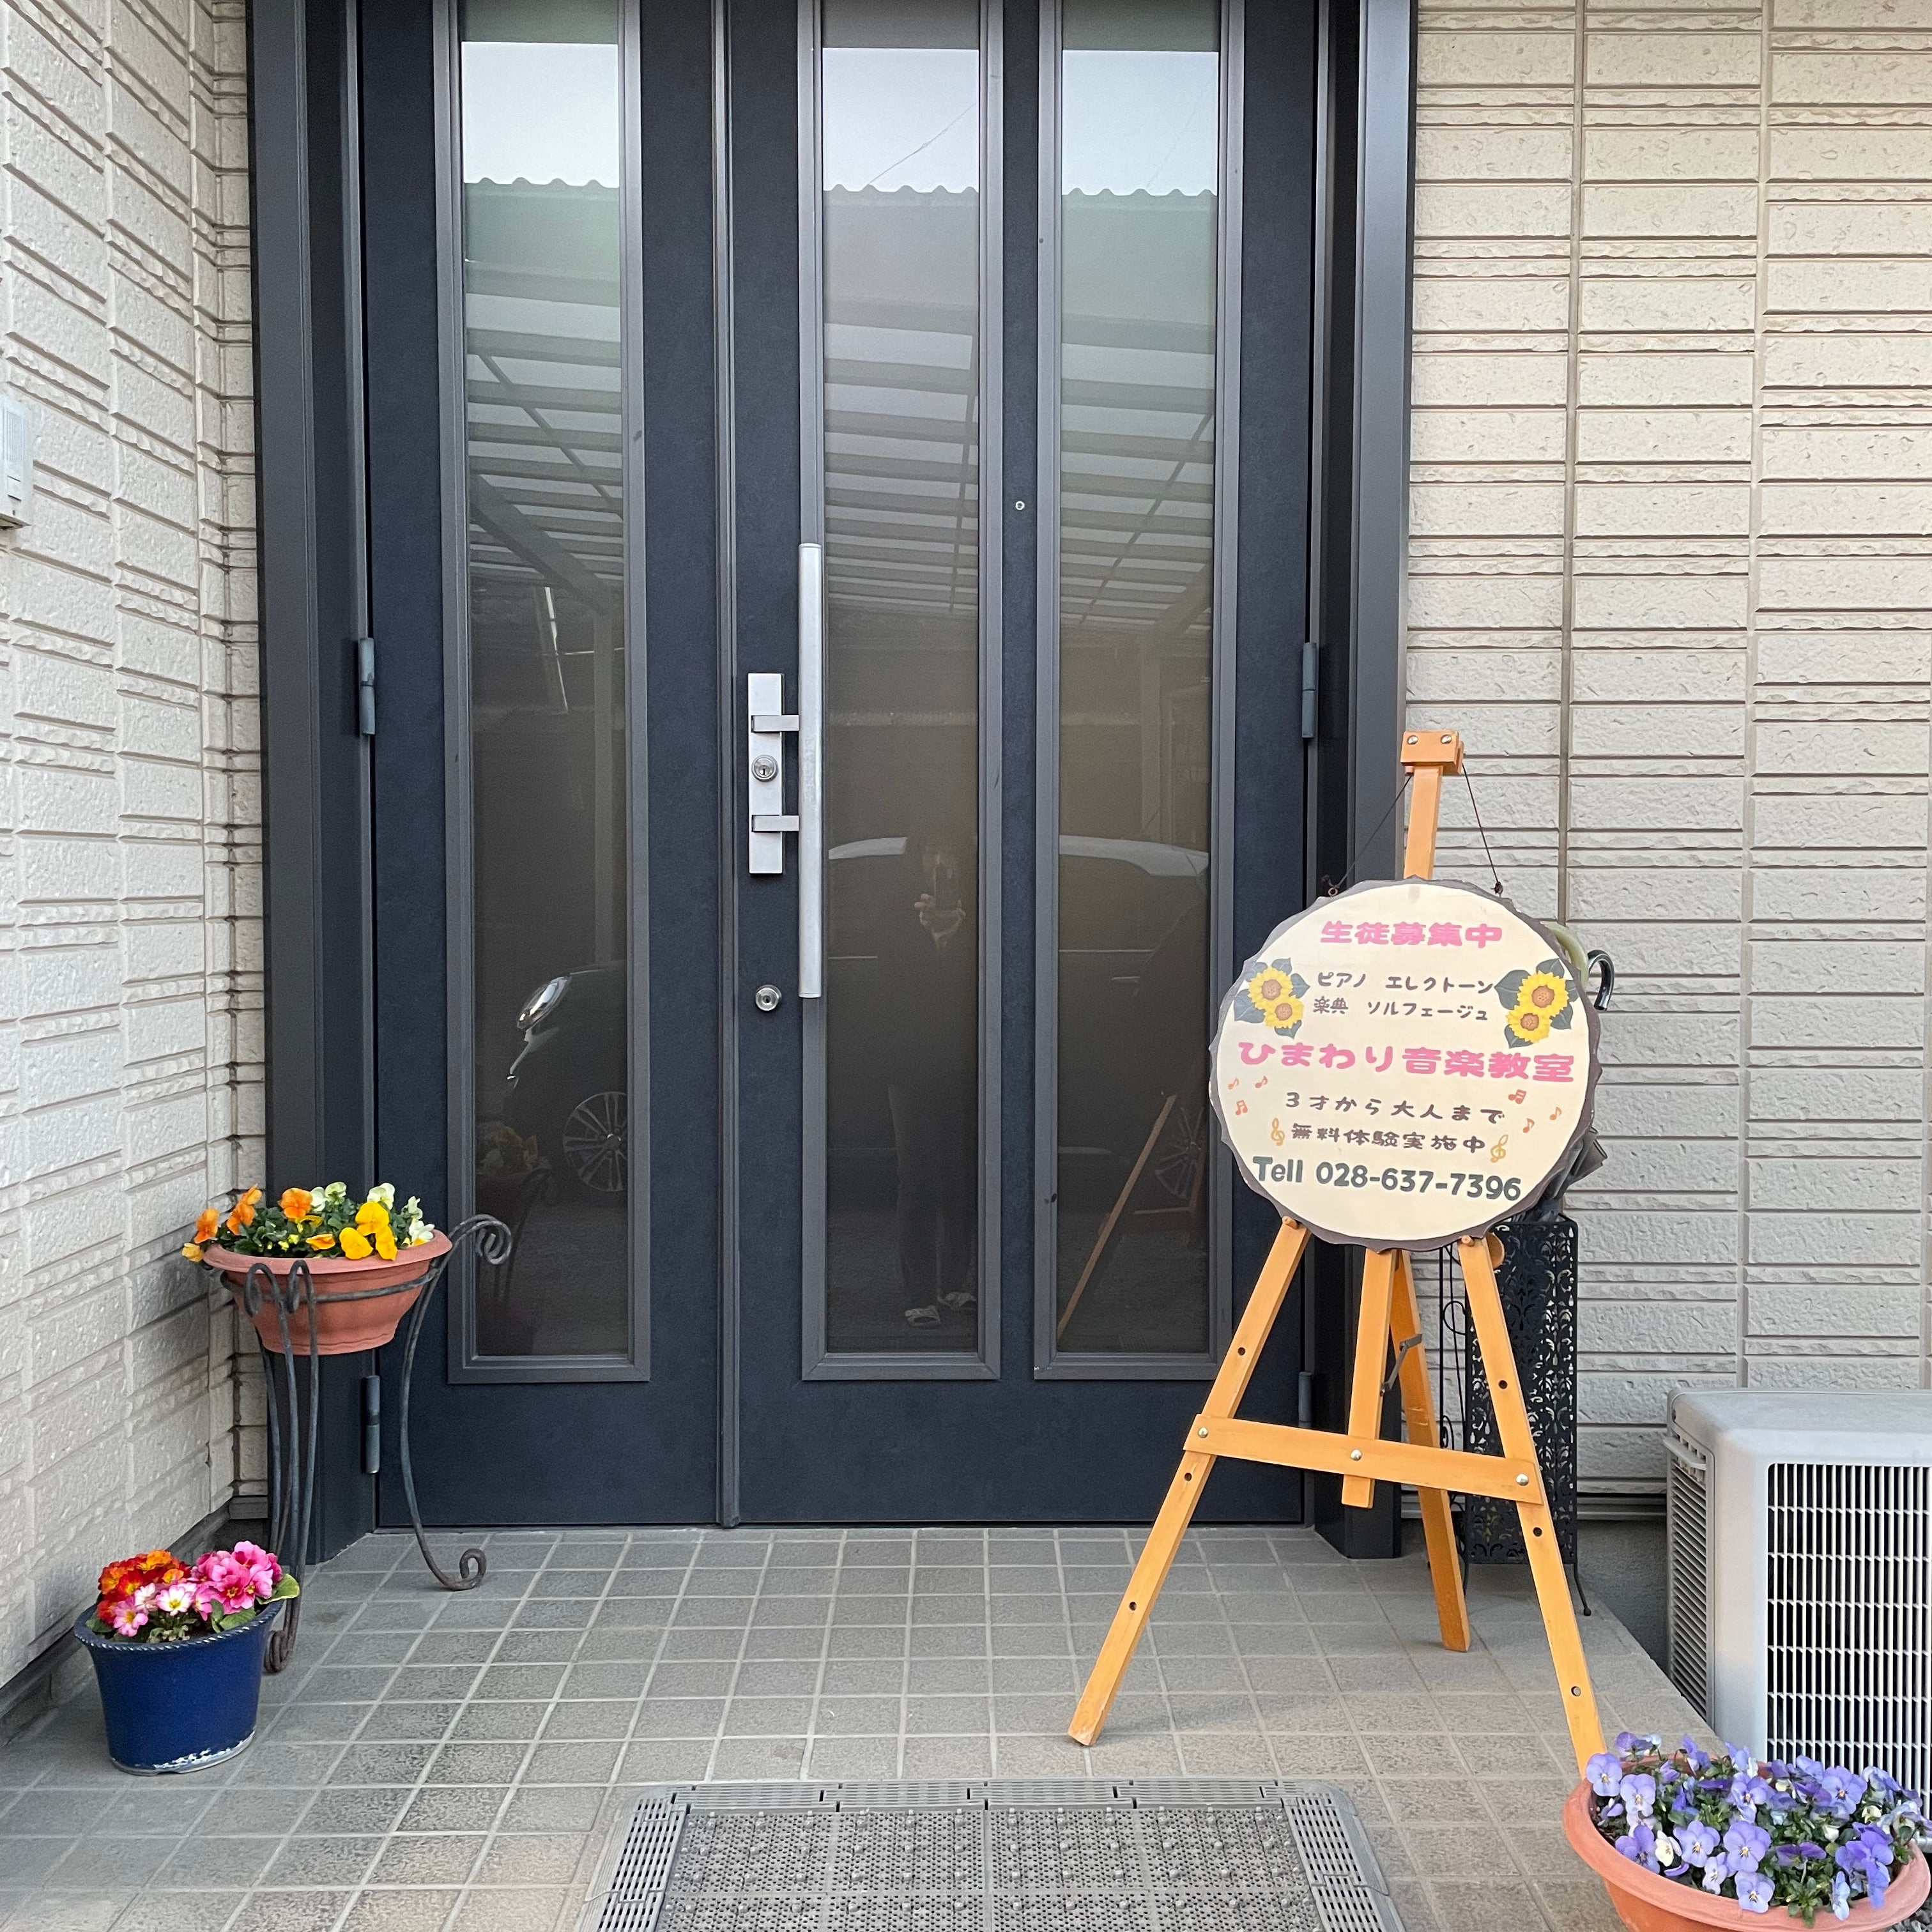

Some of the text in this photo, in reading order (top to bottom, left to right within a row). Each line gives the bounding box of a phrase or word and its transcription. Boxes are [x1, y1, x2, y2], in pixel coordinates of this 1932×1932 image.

[1321, 921, 1503, 949] 生徒募集中
[1317, 971, 1494, 994] ピアノ エレクトーン
[1312, 995, 1489, 1021] 楽典 ソルフェージュ
[1238, 1041, 1574, 1083] ひまわり音楽教室
[1285, 1092, 1505, 1124] 3才から大人まで
[1291, 1123, 1486, 1154] 無料体験実施中
[1253, 1156, 1522, 1201] Tell 028-637-7396
